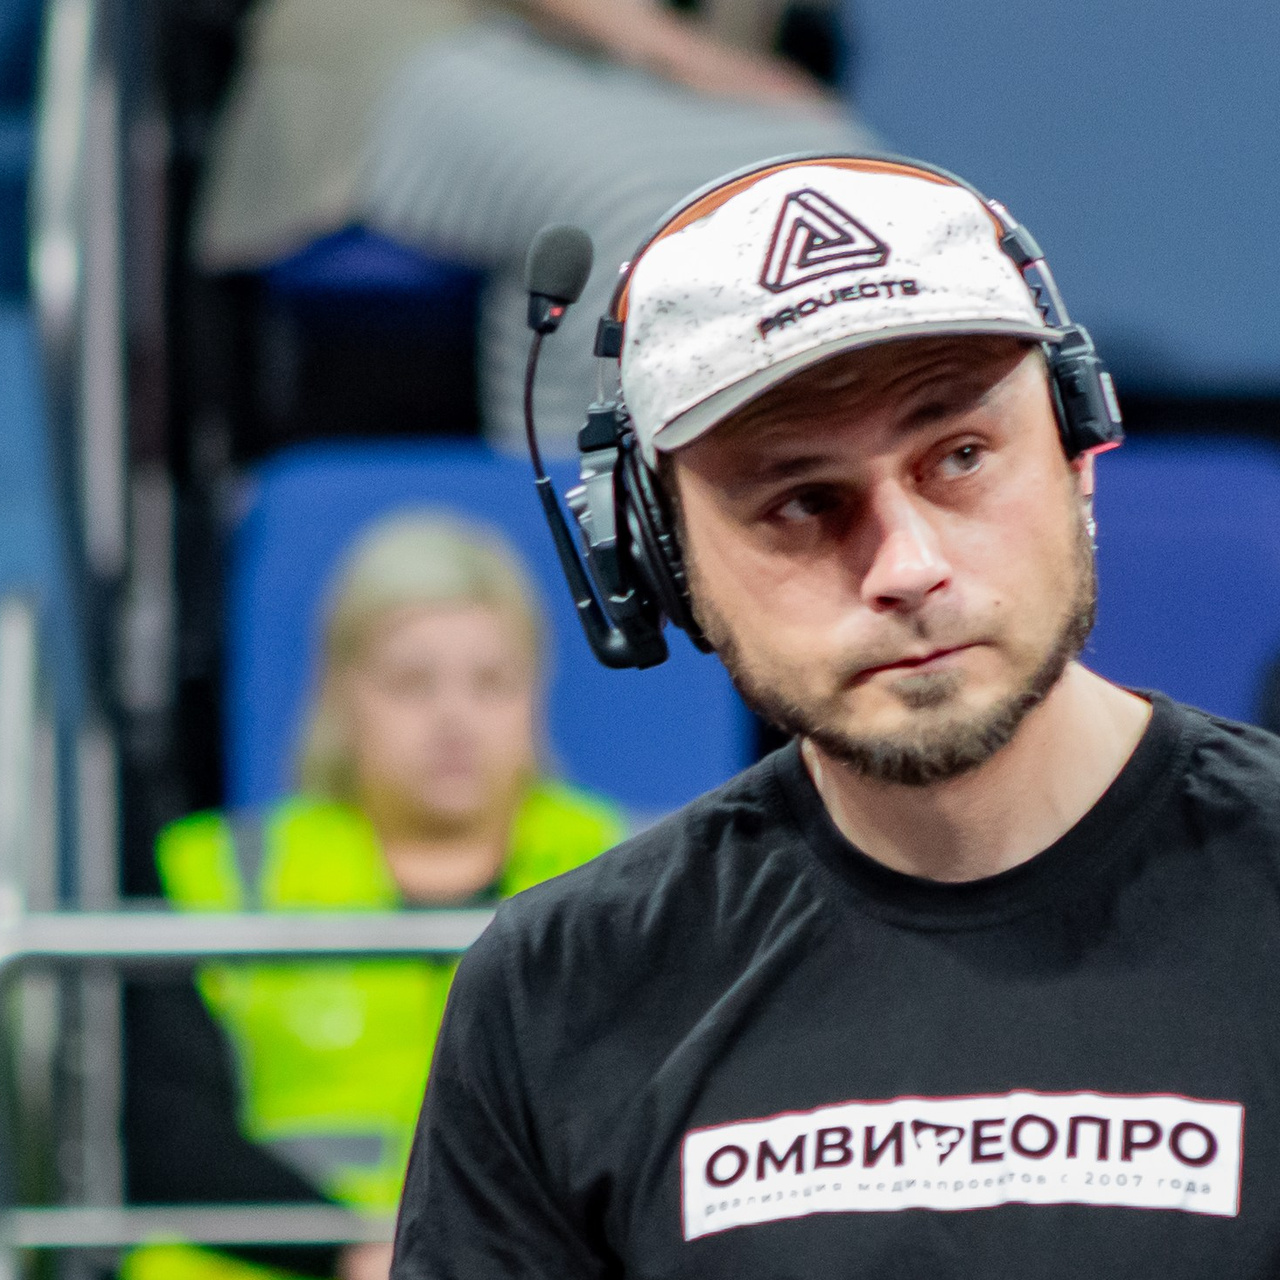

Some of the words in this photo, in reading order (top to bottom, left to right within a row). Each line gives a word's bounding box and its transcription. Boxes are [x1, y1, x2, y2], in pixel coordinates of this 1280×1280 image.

[757, 280, 919, 340] PROJECTS
[704, 1182, 843, 1217] реализация
[858, 1172, 1047, 1194] медиапроектов
[1084, 1171, 1143, 1188] 2007
[1158, 1178, 1212, 1195] года
